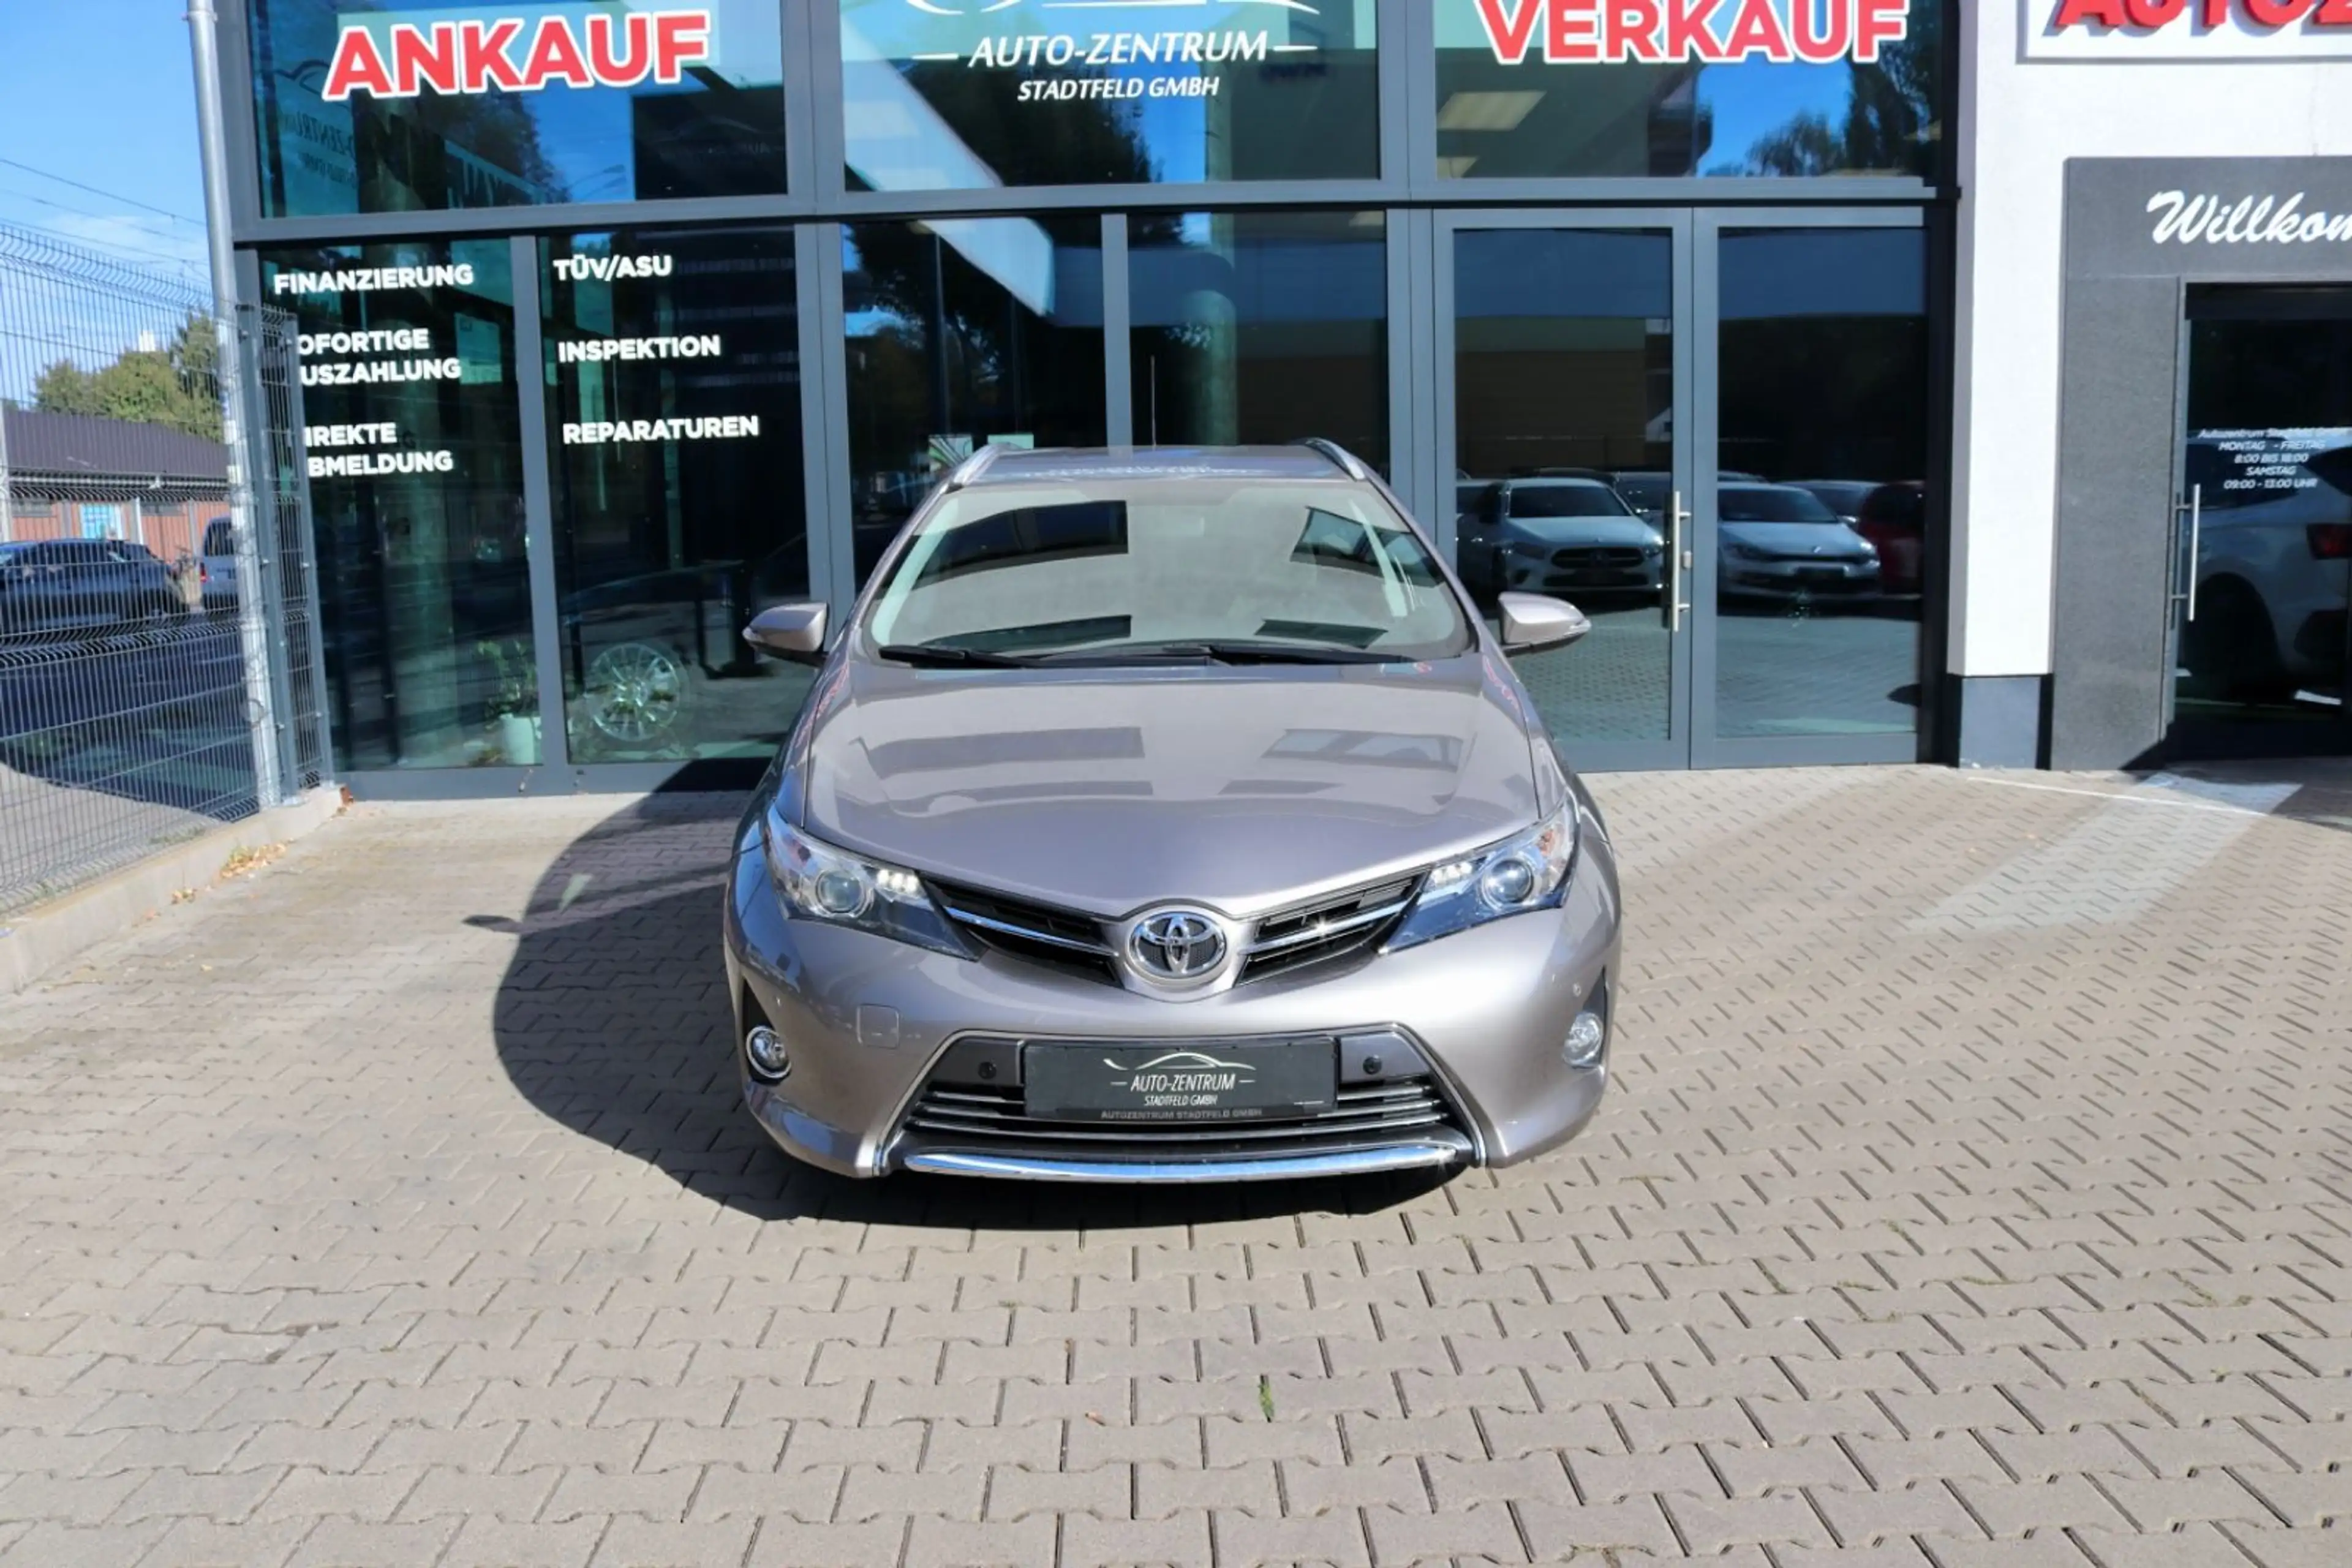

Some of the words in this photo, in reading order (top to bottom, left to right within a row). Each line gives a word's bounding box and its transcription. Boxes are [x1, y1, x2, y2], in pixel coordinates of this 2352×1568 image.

[1476, 0, 1911, 66] VERKAUF
[322, 9, 711, 101] ANKAUF
[968, 30, 1268, 69] AUTO-ZENTRUM
[1017, 77, 1144, 101] STADTFELD
[1148, 76, 1220, 97] GMBH
[274, 263, 474, 295] FINANZIERUNG
[553, 254, 673, 282] TÜV/ASU
[298, 328, 430, 355] OFORTIGE
[558, 334, 721, 363] INSPEKTION
[301, 357, 462, 386] USZAHLUNG
[305, 421, 398, 447] IREKTE
[562, 415, 760, 445] REPARATUREN
[2217, 440, 2266, 451] MONTAG
[307, 450, 454, 478] BMELDUNG
[2245, 466, 2297, 477] SAMSTAG
[1130, 1073, 1237, 1093] AUTO-ZENTRUM
